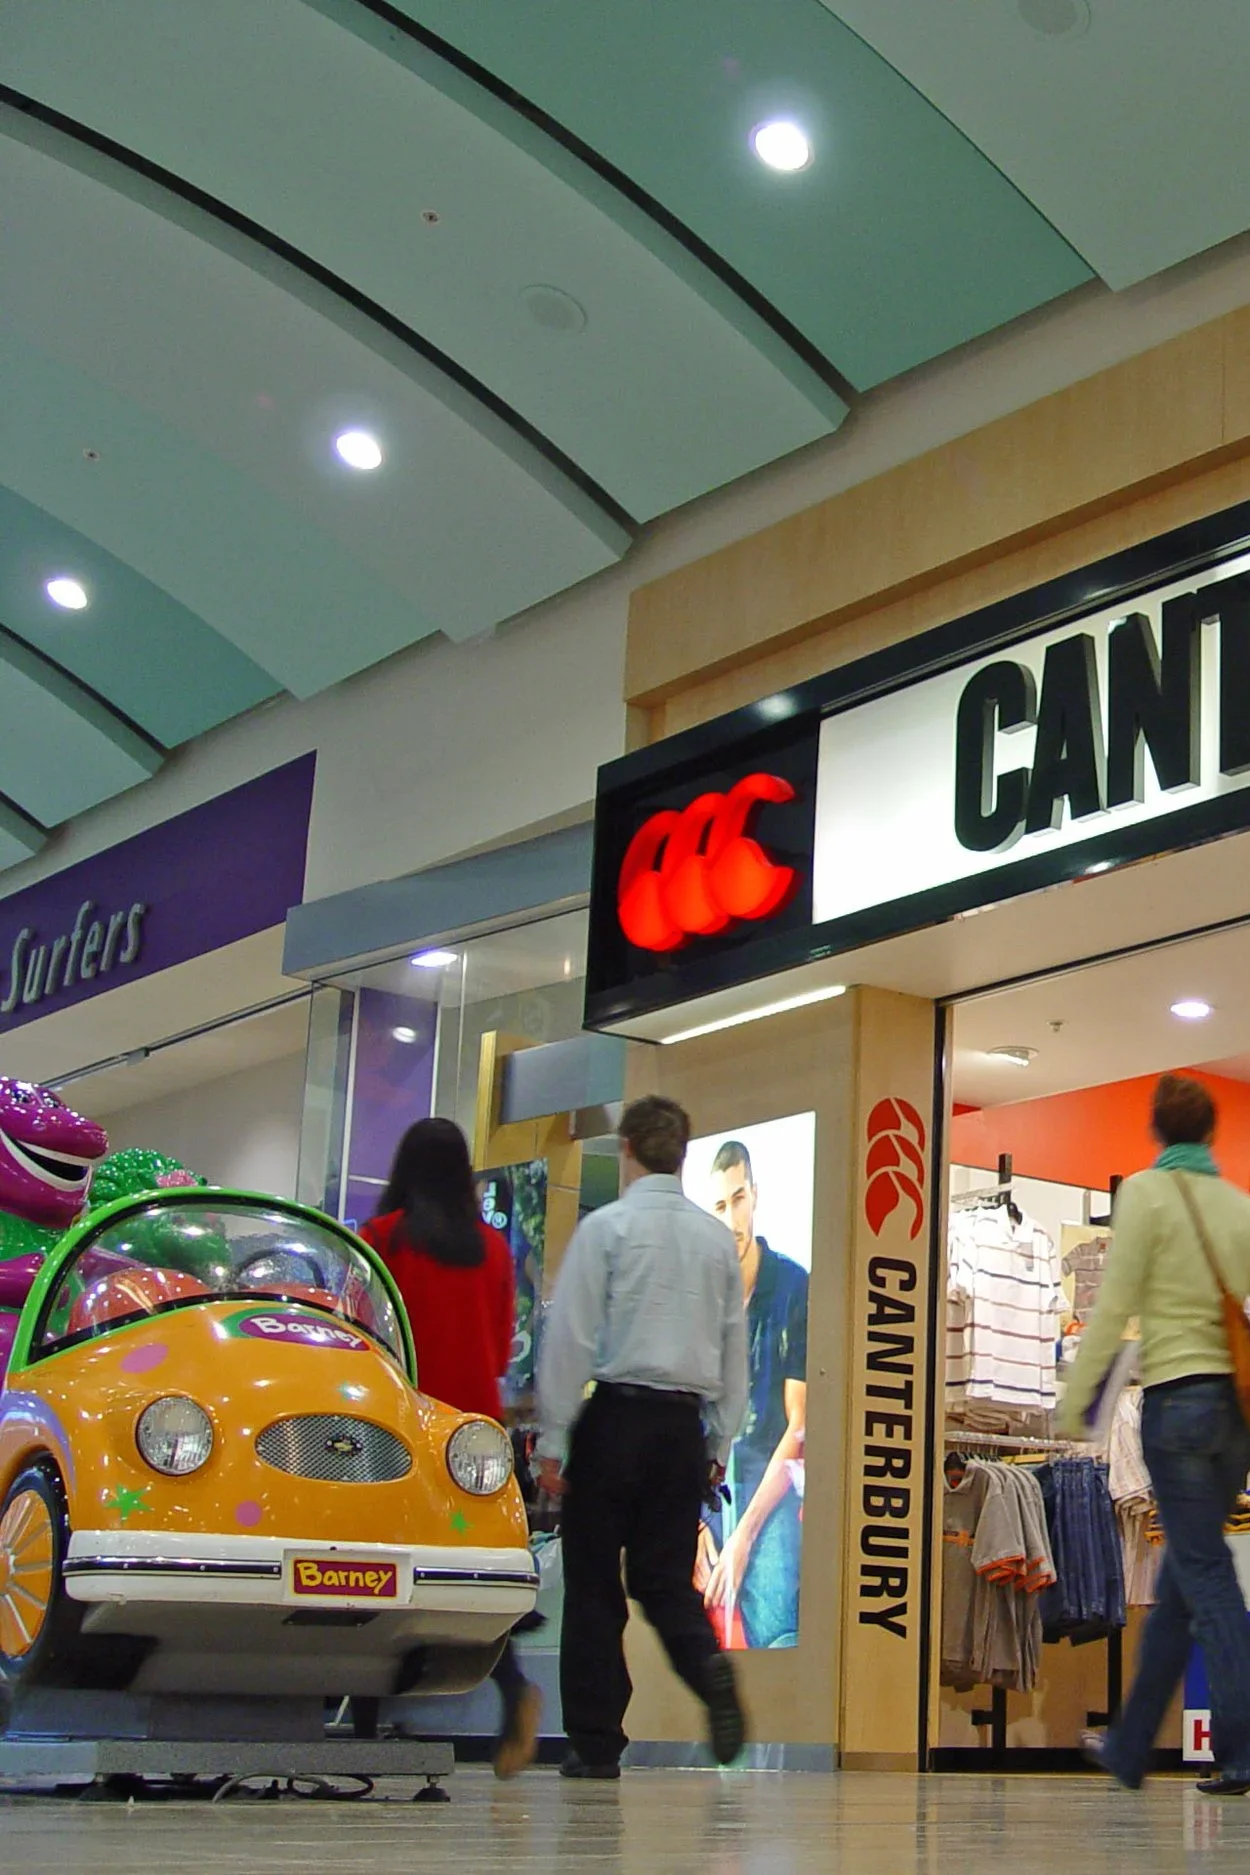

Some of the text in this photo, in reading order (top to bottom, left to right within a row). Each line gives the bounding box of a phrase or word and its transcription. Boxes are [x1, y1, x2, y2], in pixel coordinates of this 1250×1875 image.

[1, 900, 148, 1012] Surfers
[251, 1316, 364, 1348] Barney
[859, 1256, 916, 1639] CANTERBURY
[296, 1561, 393, 1595] Barney
